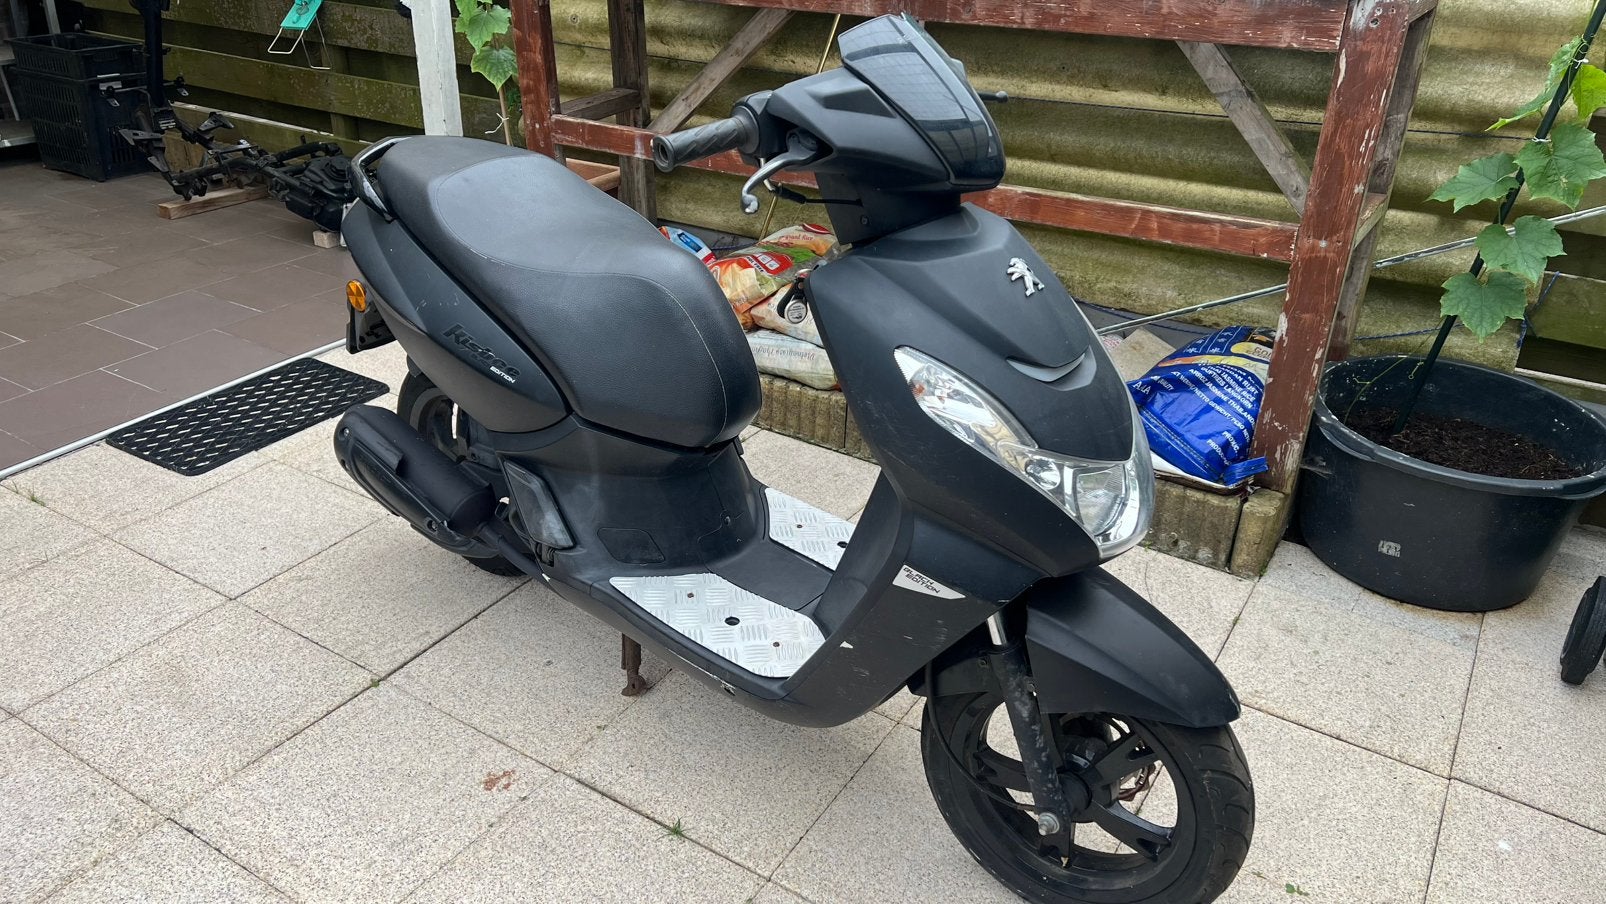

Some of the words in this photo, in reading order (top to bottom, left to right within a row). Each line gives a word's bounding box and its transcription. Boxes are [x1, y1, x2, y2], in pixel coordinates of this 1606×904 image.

[490, 366, 516, 383] EDITION
[1207, 381, 1230, 402] JASMINE
[1221, 371, 1243, 392] JASMINE
[1241, 390, 1256, 402] RICE
[1224, 384, 1253, 409] LANGKORN
[905, 573, 941, 594] EDITION
